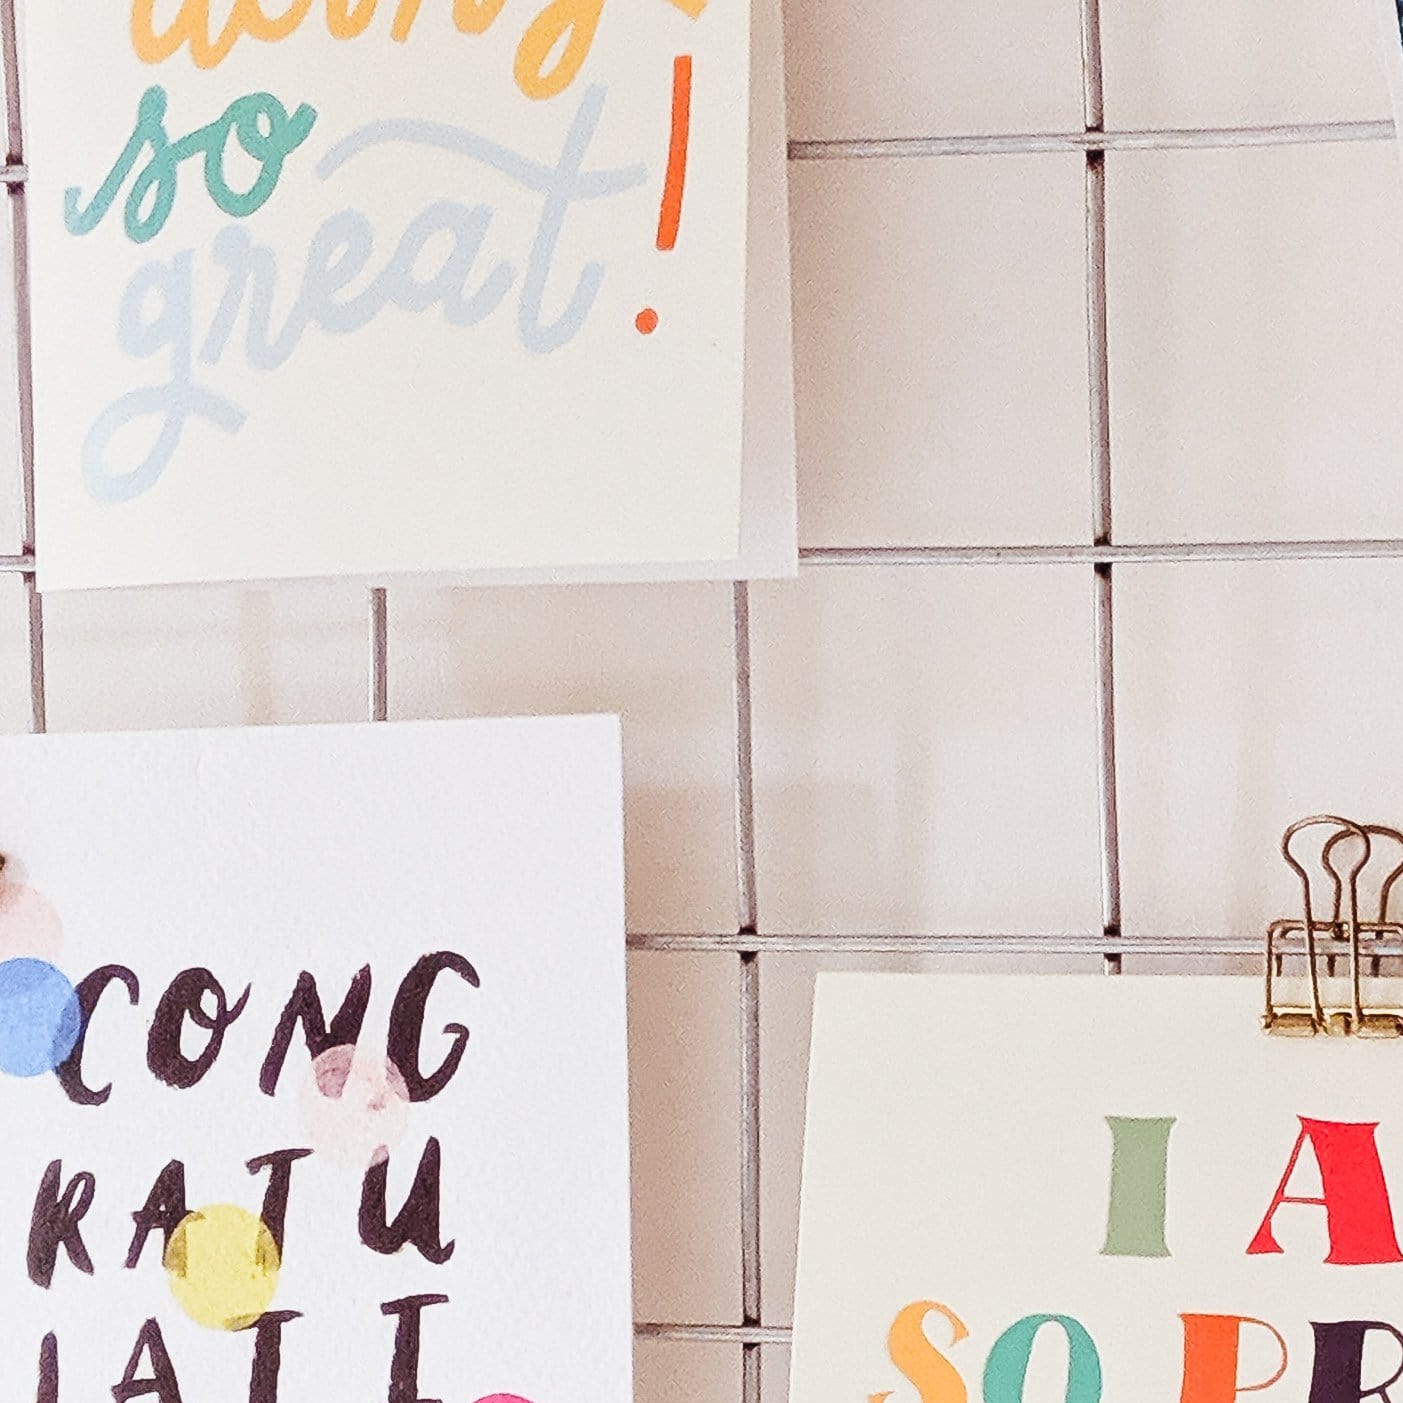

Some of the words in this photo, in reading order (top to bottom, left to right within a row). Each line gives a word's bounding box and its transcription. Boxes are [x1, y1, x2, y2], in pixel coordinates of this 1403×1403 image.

[64, 84, 318, 243] so
[54, 950, 480, 1106] CONG
[26, 1135, 456, 1289] RATU
[1099, 1114, 1178, 1259] I
